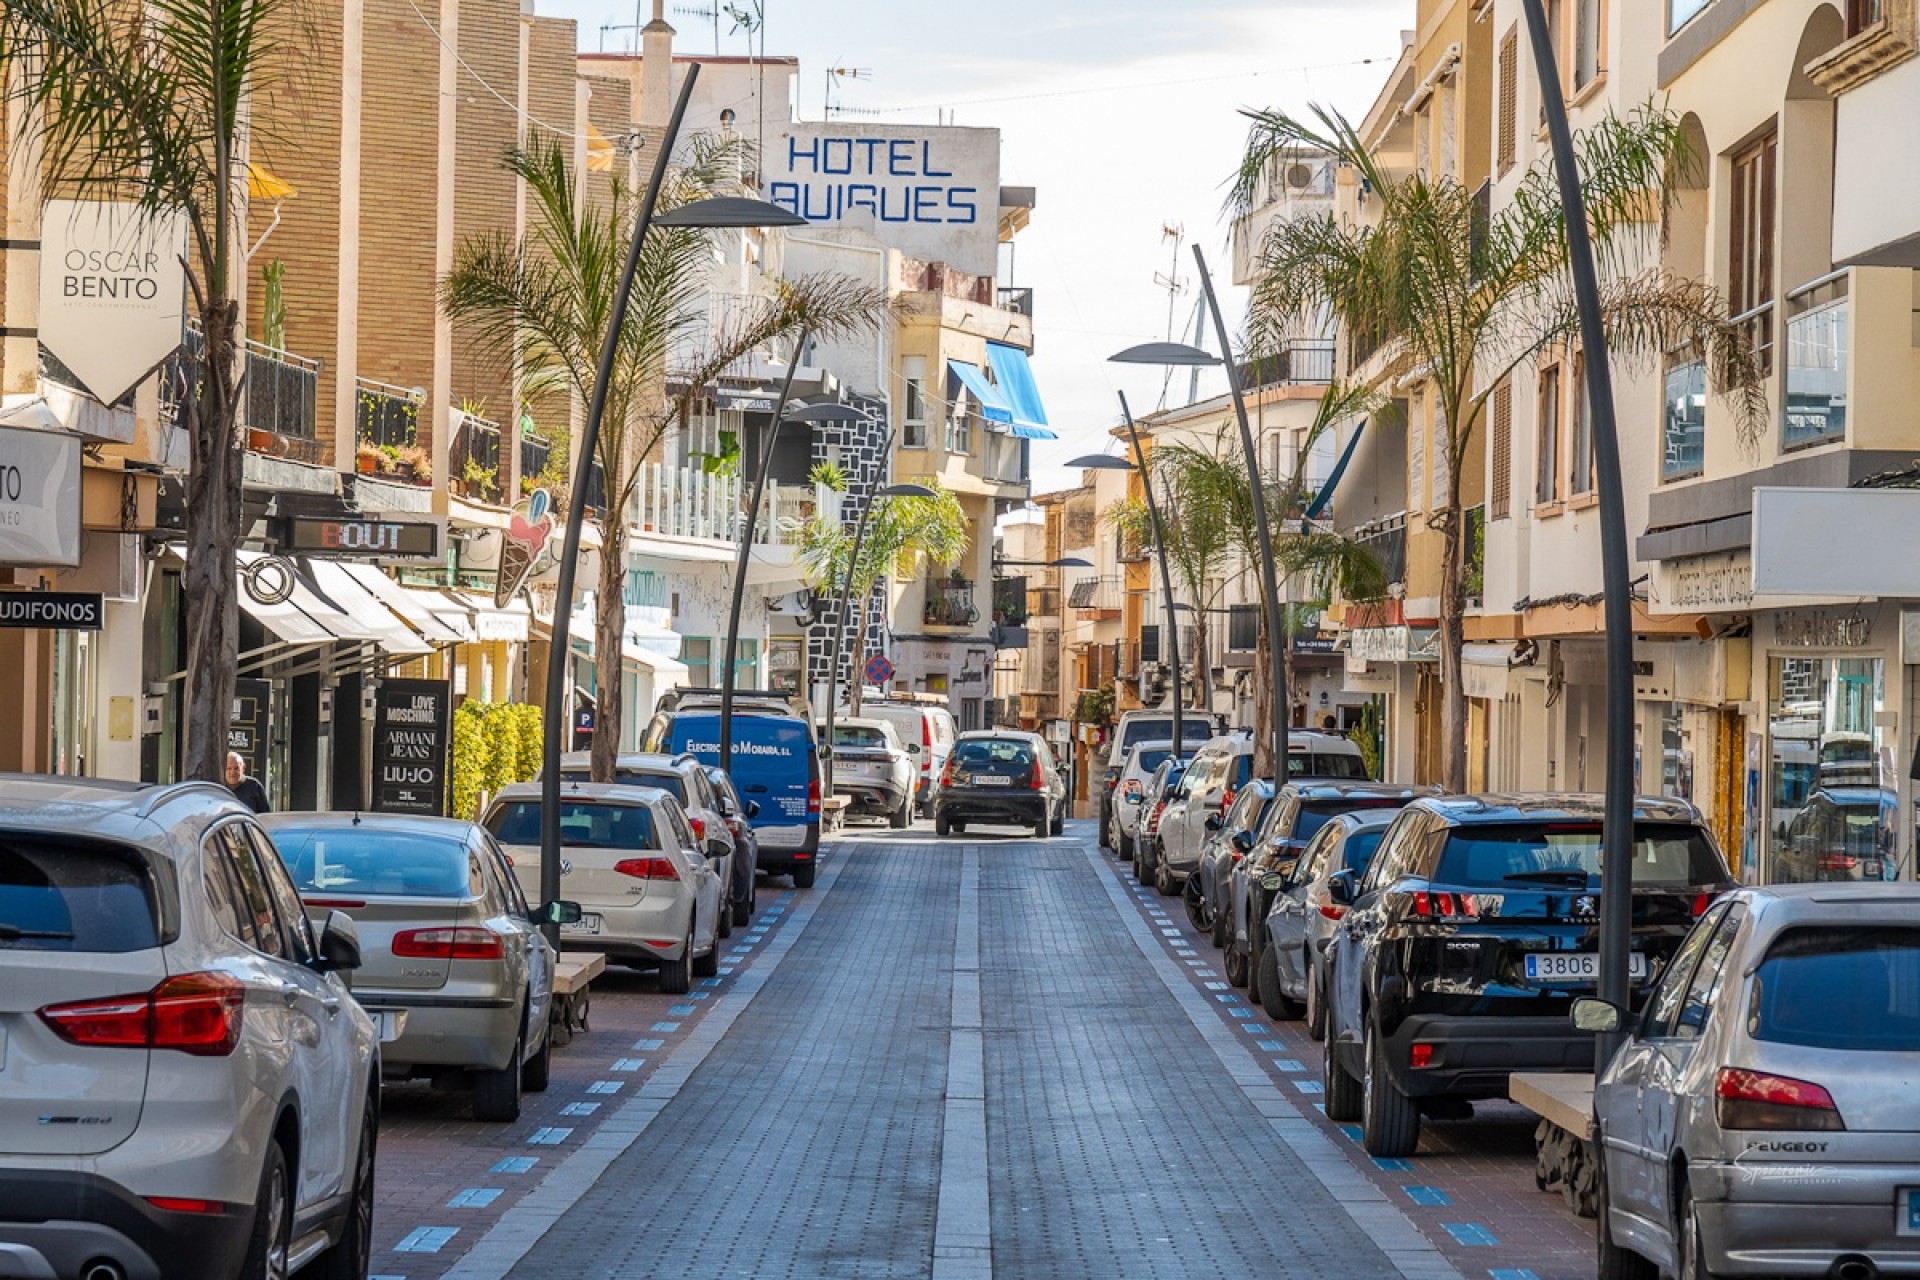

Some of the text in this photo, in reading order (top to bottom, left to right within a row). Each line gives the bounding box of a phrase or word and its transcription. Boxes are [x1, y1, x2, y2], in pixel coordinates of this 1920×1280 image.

[788, 136, 953, 177] HOTEL
[65, 248, 159, 273] OSCAR
[63, 275, 158, 300] BENTO
[411, 695, 436, 710] LOVE
[581, 712, 591, 726] P
[387, 730, 436, 745] ARMANI
[390, 745, 431, 759] JEANS
[1446, 942, 1481, 950] 3008
[1542, 956, 1594, 975] 3806
[1747, 1141, 1829, 1153] PEUGEOT
